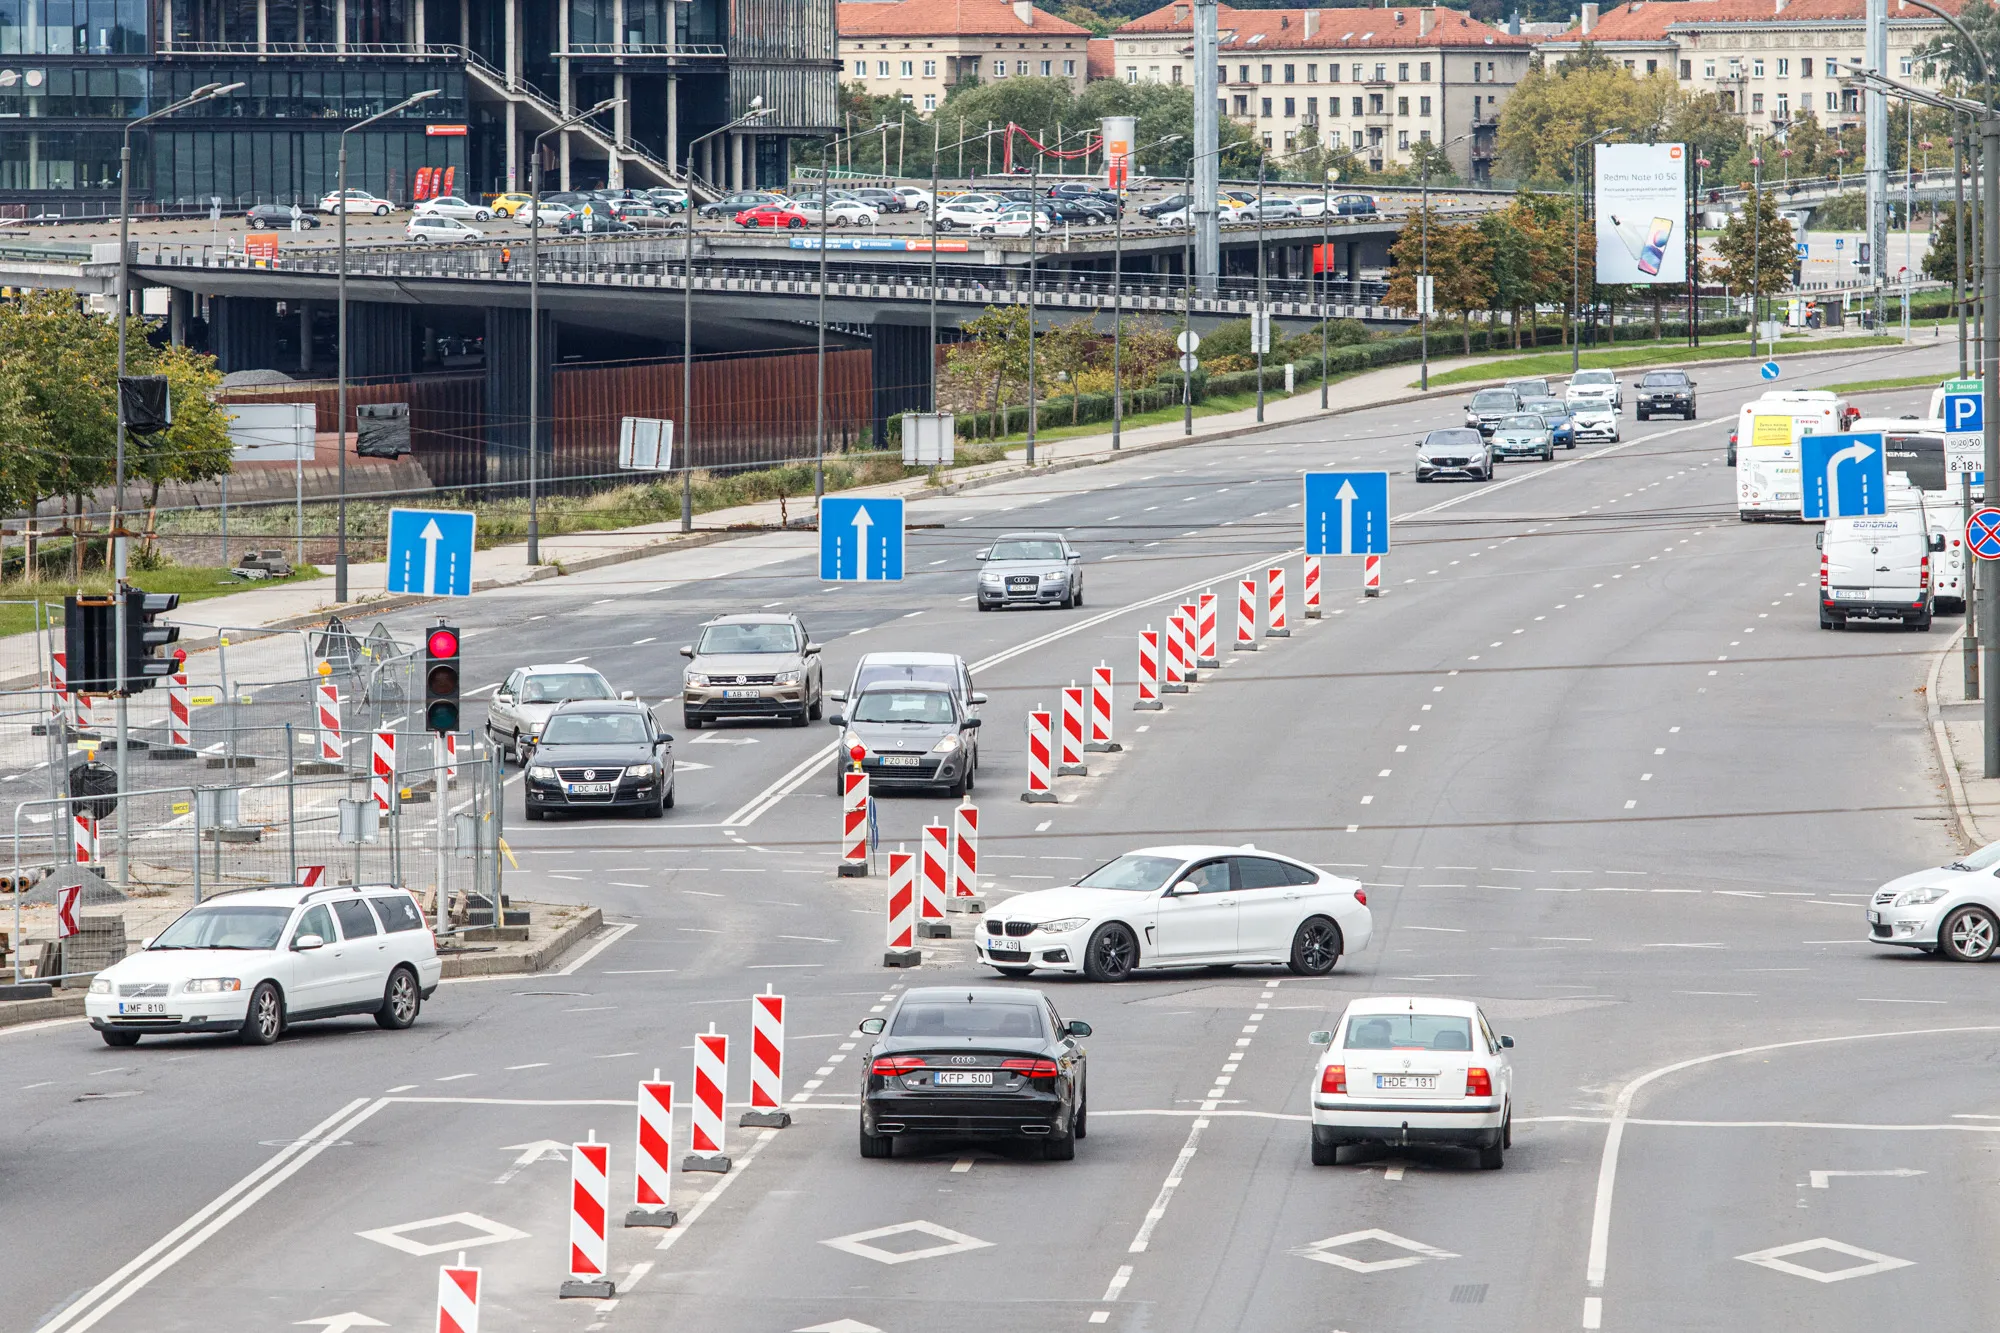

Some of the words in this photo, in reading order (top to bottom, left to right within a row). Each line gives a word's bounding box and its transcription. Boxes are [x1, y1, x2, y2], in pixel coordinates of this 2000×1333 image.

[1603, 173, 1629, 181] Redmi
[1631, 173, 1652, 181] Note
[1654, 173, 1664, 181] 10
[1666, 172, 1678, 181] 5G
[1954, 398, 1976, 429] P
[1969, 438, 1980, 447] 50
[1951, 461, 1974, 471] 8-18
[1975, 461, 1982, 470] h
[884, 757, 900, 765] FZO
[573, 785, 589, 793] LDC
[991, 940, 1003, 949] LPP
[1006, 941, 1018, 950] 430
[125, 1003, 142, 1013] JMF
[147, 1003, 164, 1013] 810
[941, 1073, 964, 1083] KFP
[971, 1073, 991, 1083] 500
[1383, 1077, 1407, 1087] HDE
[1415, 1078, 1433, 1087] 131
